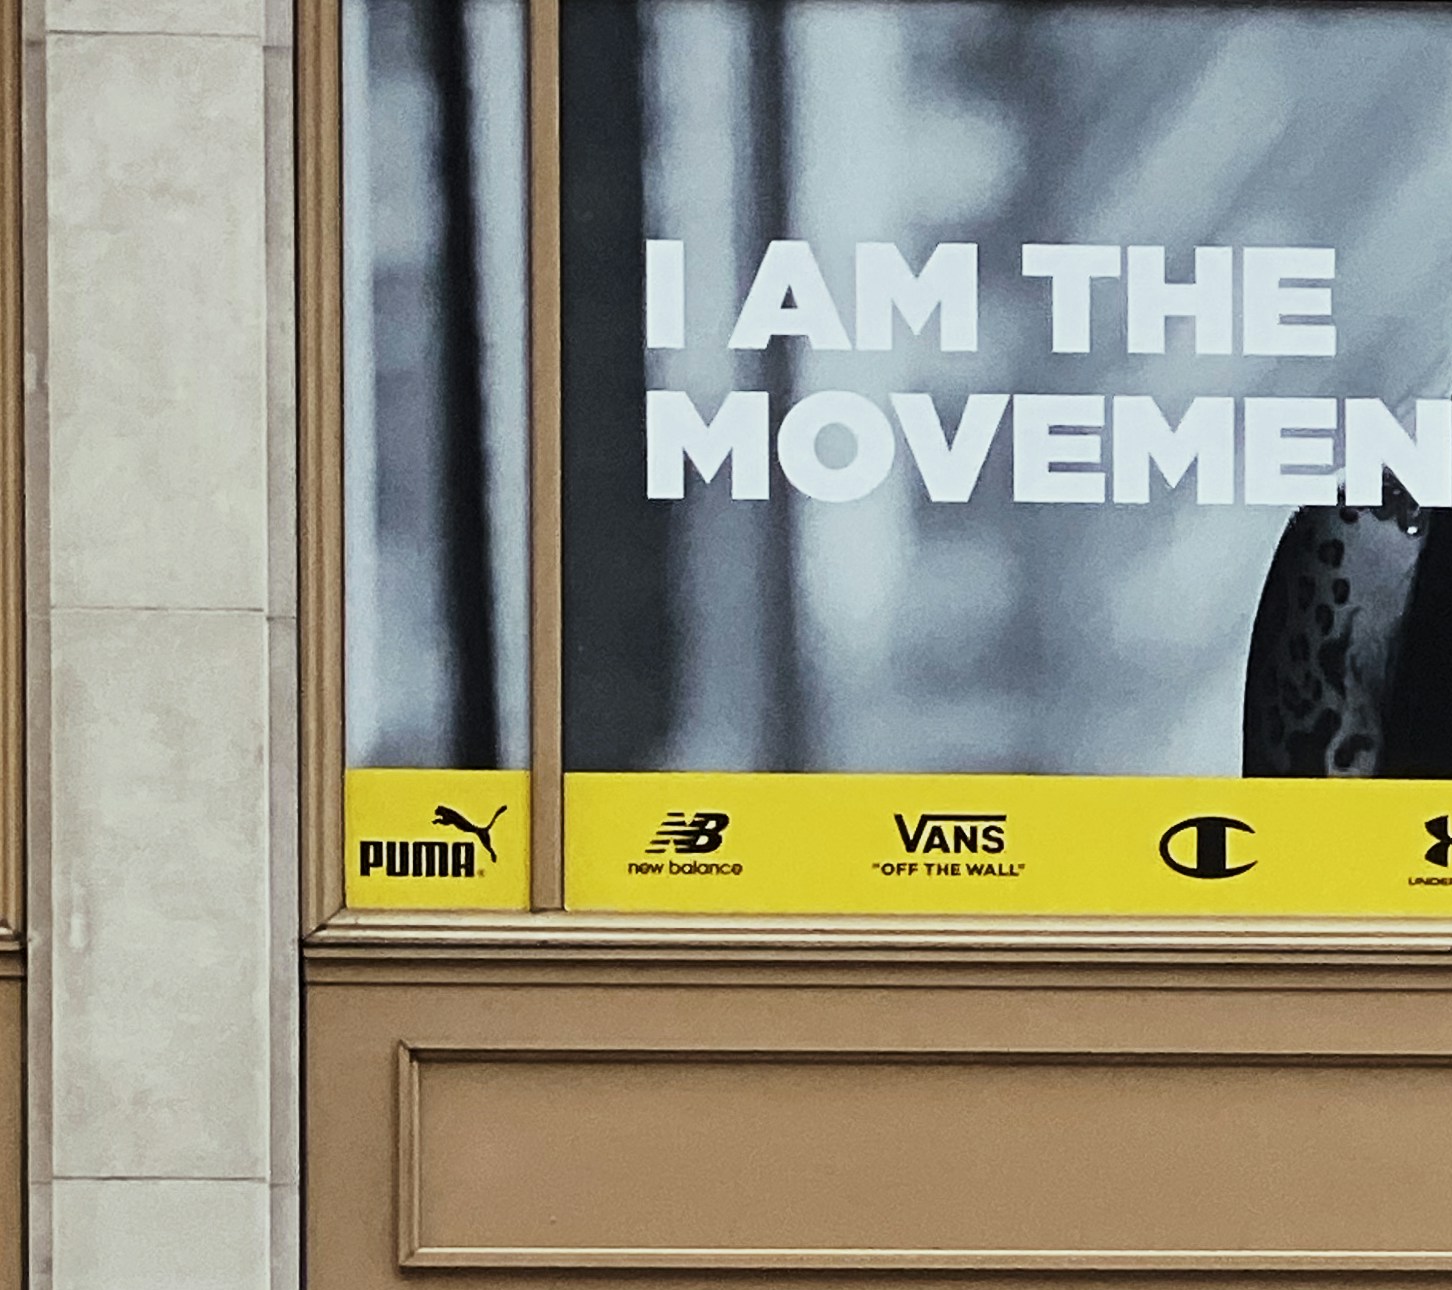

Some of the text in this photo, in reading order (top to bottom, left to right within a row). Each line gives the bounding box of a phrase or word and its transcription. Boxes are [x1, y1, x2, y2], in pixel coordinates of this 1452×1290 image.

[646, 240, 1336, 356] I AM THE
[894, 813, 1007, 854] VANS
[360, 841, 475, 877] PUMA
[627, 860, 743, 876] new balance
[924, 863, 961, 876] THE
